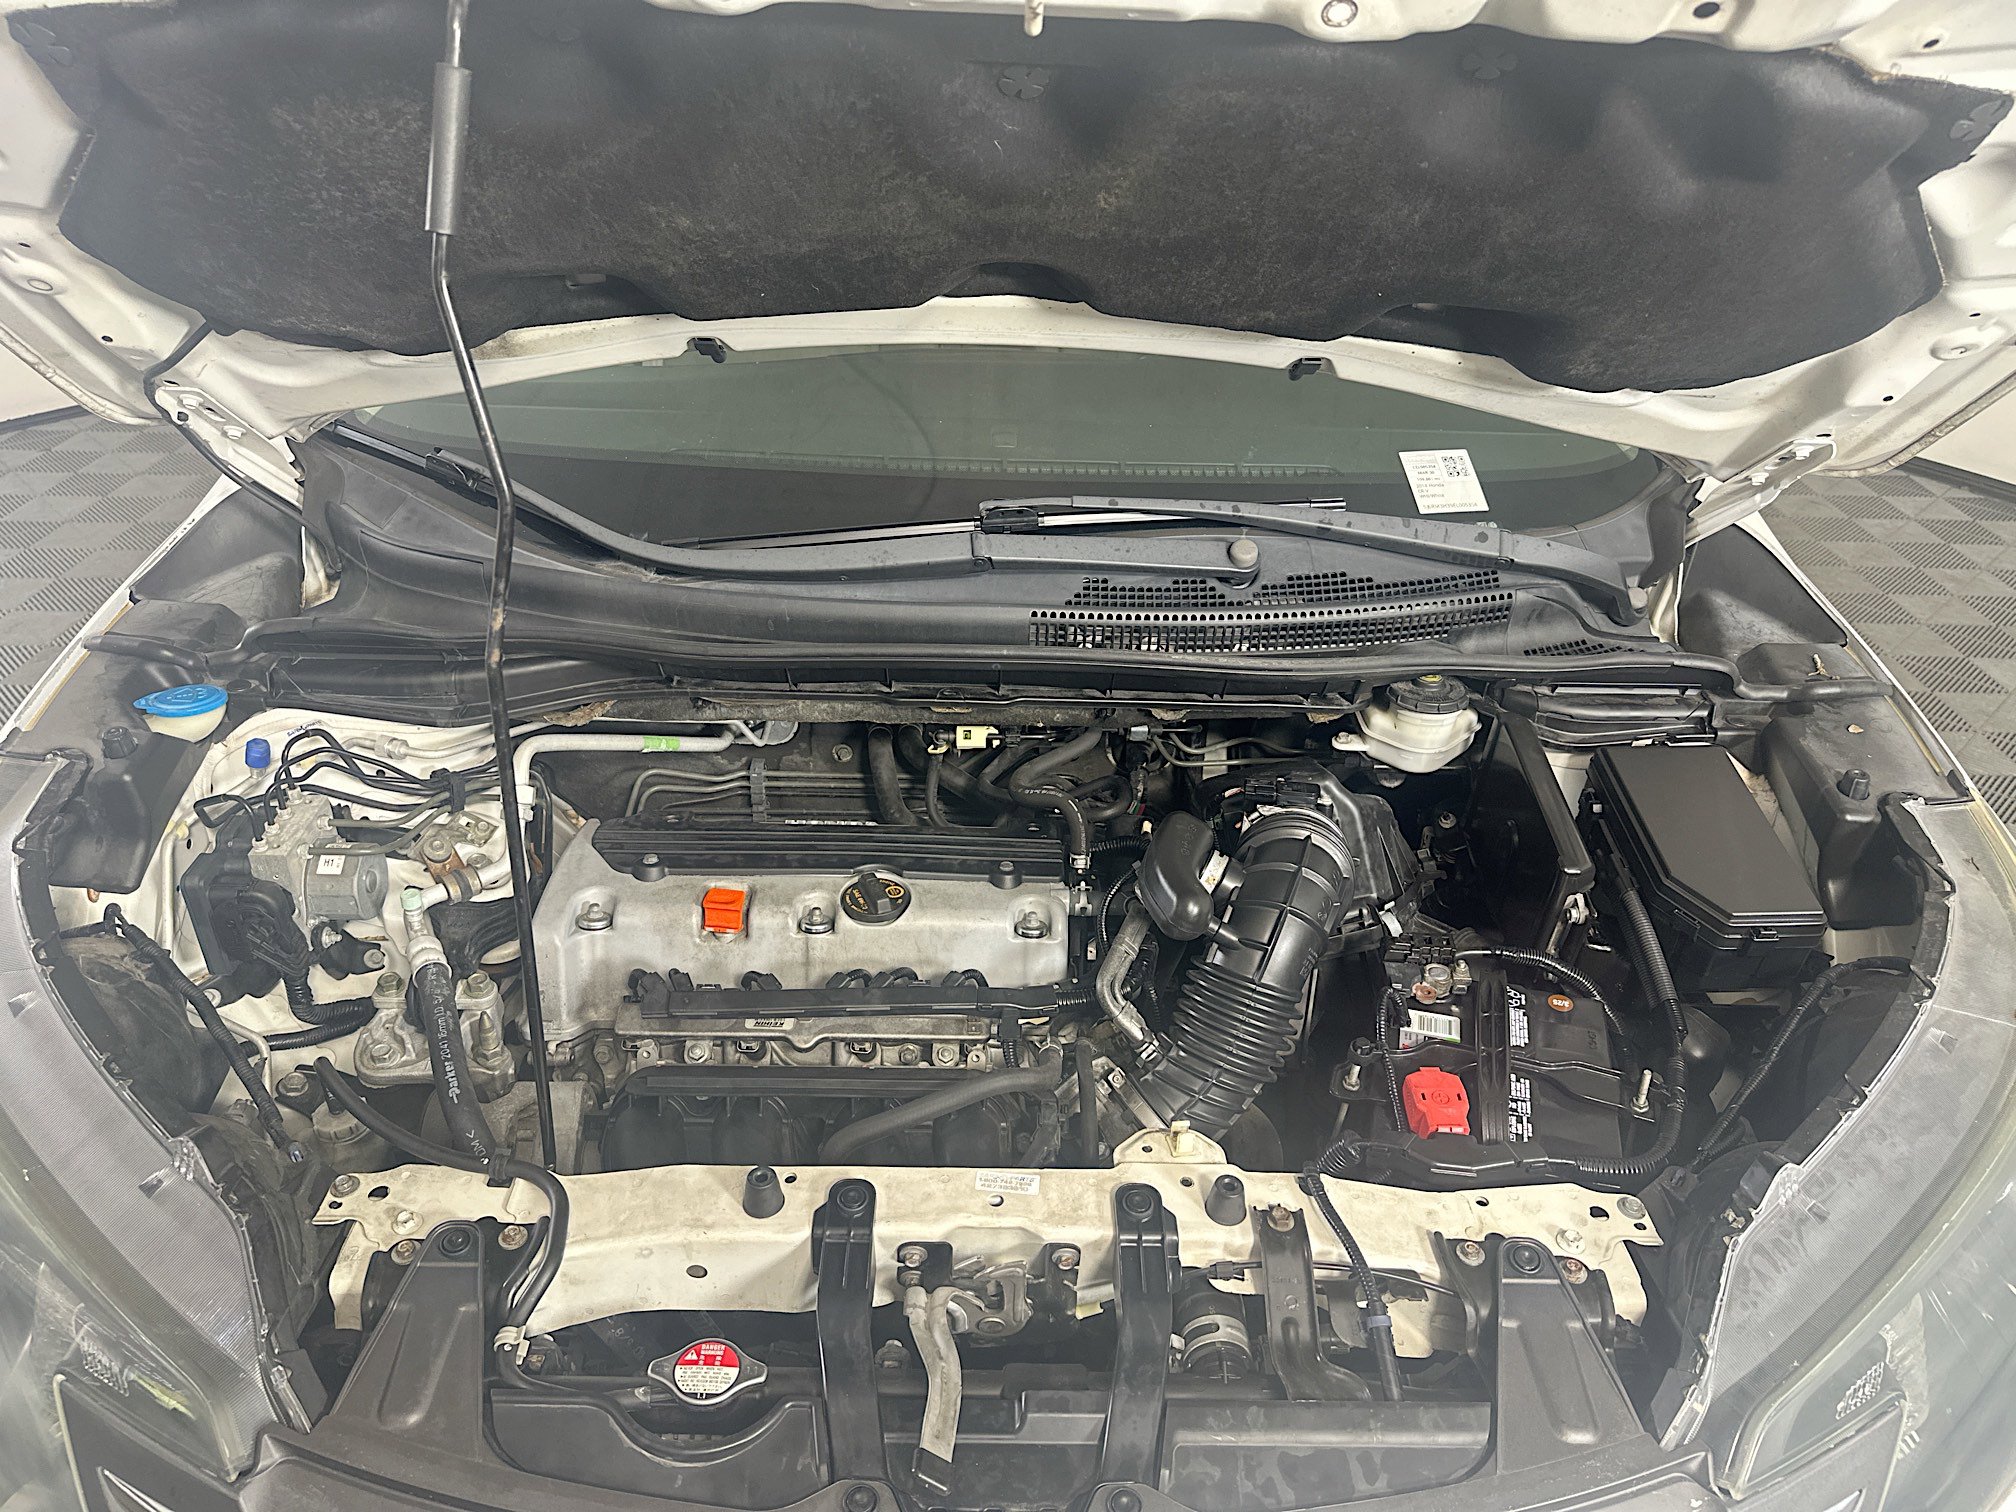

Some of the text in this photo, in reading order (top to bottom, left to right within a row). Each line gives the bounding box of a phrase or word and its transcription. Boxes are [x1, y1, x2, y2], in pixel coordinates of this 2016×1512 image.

[323, 858, 334, 867] H1
[1552, 998, 1570, 1008] 3/25
[439, 1039, 452, 1060] 2041
[444, 1060, 461, 1104] Parker
